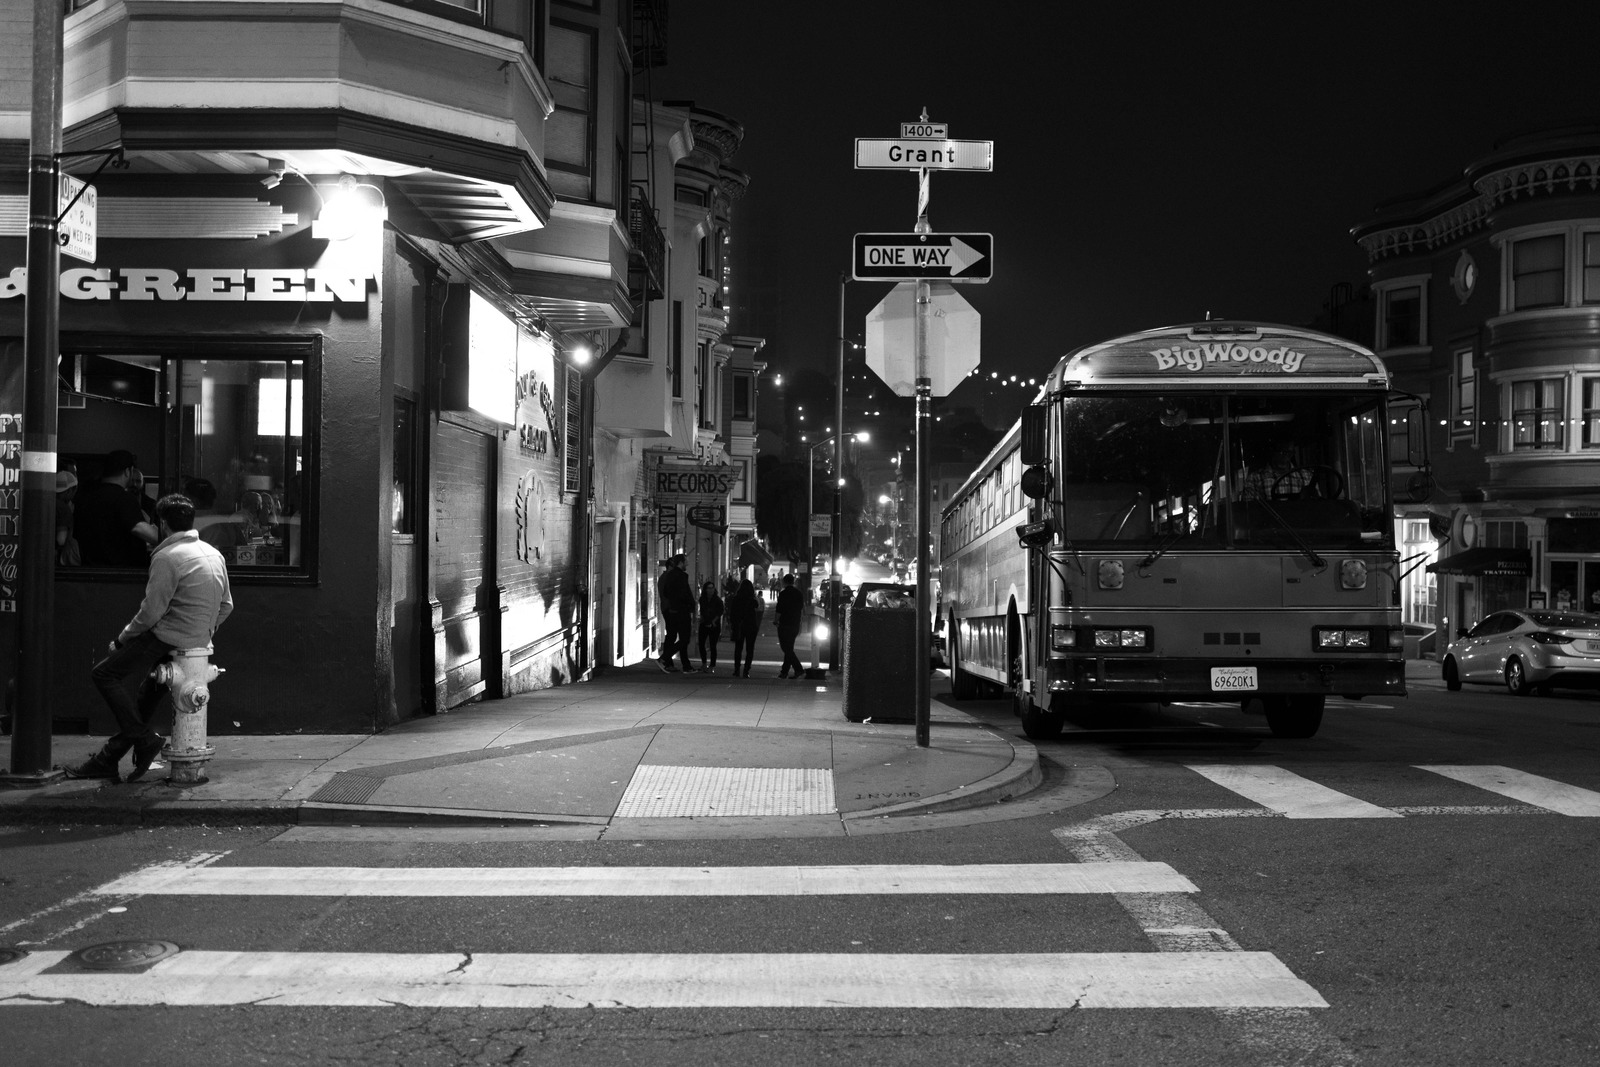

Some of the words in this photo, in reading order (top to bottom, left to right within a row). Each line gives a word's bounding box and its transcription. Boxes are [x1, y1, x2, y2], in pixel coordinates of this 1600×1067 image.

[903, 125, 933, 137] 1400
[888, 145, 955, 163] Grant
[73, 227, 84, 243] WED
[84, 232, 93, 246] FRI
[869, 248, 906, 265] ONE
[912, 248, 951, 265] WAY
[59, 268, 374, 302] GREEN
[657, 472, 728, 493] RECORDS
[1497, 560, 1528, 569] PIZZERIA
